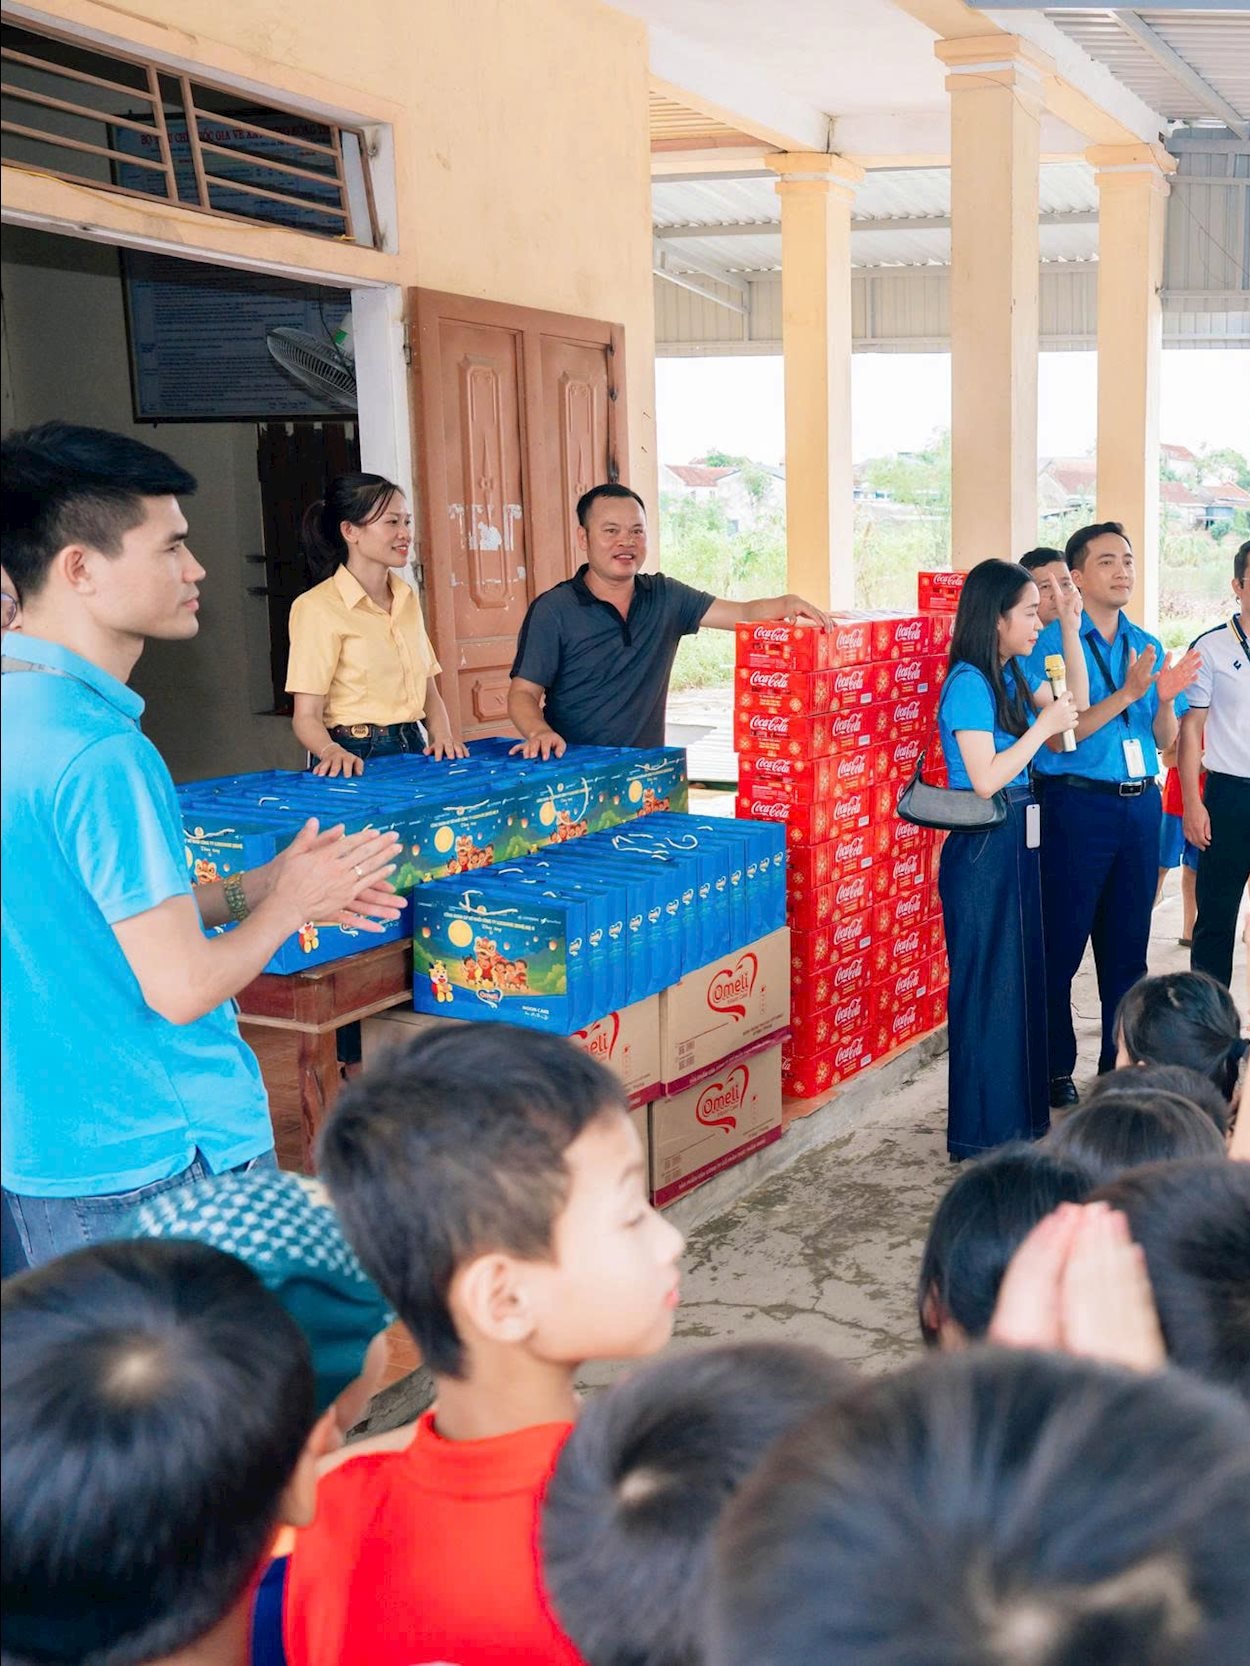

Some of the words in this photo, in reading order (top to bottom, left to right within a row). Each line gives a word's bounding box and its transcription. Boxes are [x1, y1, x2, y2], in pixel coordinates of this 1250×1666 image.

[714, 973, 749, 1001] Omeli
[583, 1033, 609, 1055] eli
[703, 1084, 740, 1114] Omeli
